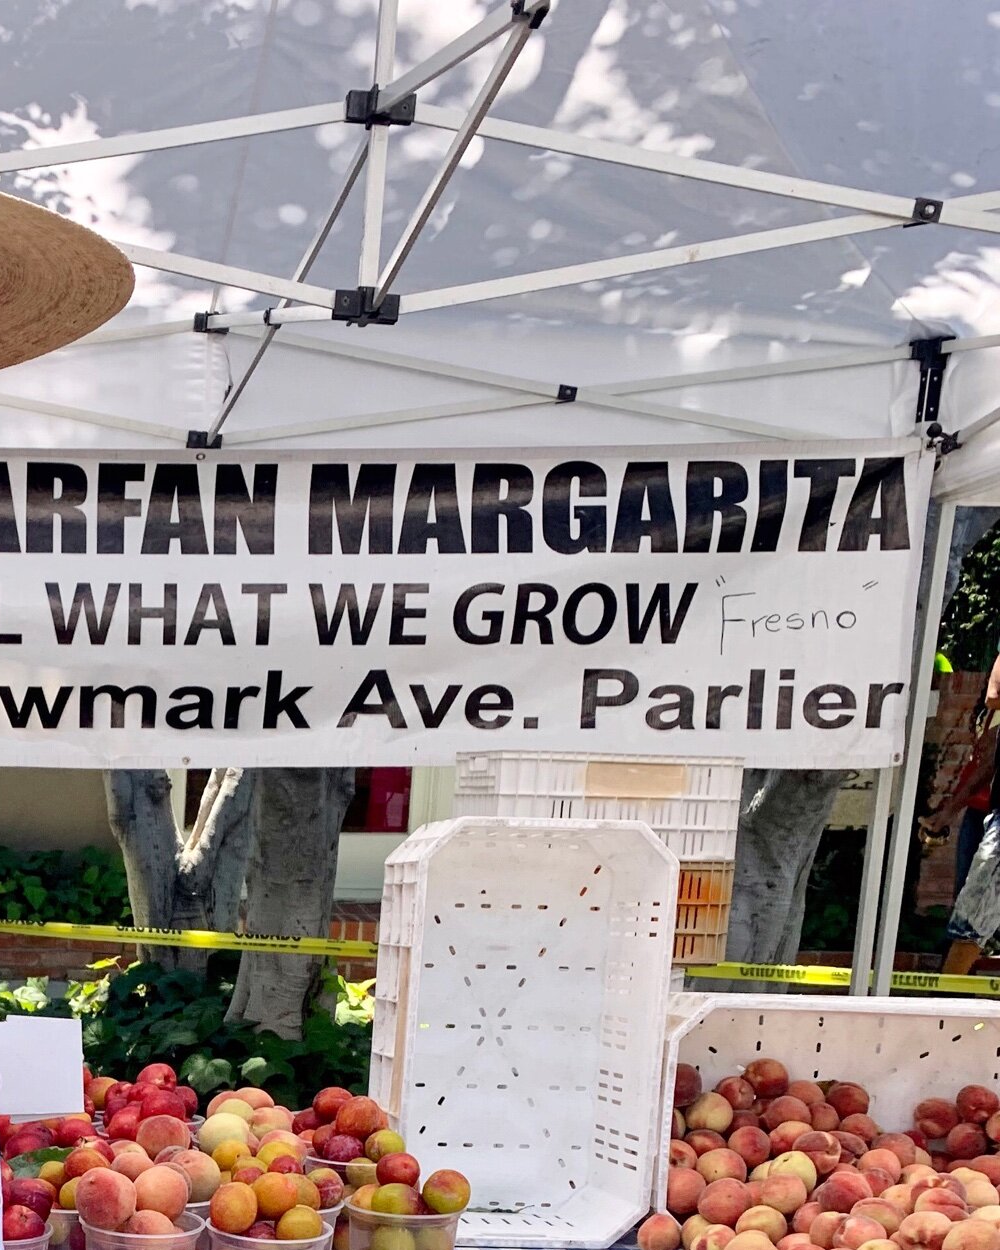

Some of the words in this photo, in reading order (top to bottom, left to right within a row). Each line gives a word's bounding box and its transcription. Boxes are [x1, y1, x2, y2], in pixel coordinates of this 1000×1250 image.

[308, 457, 910, 555] MARGARITA
[44, 582, 288, 646] WHAT
[308, 582, 430, 646] WE
[453, 582, 699, 646] GROW
[336, 668, 539, 730] Ave.
[579, 668, 905, 731] Parlier
